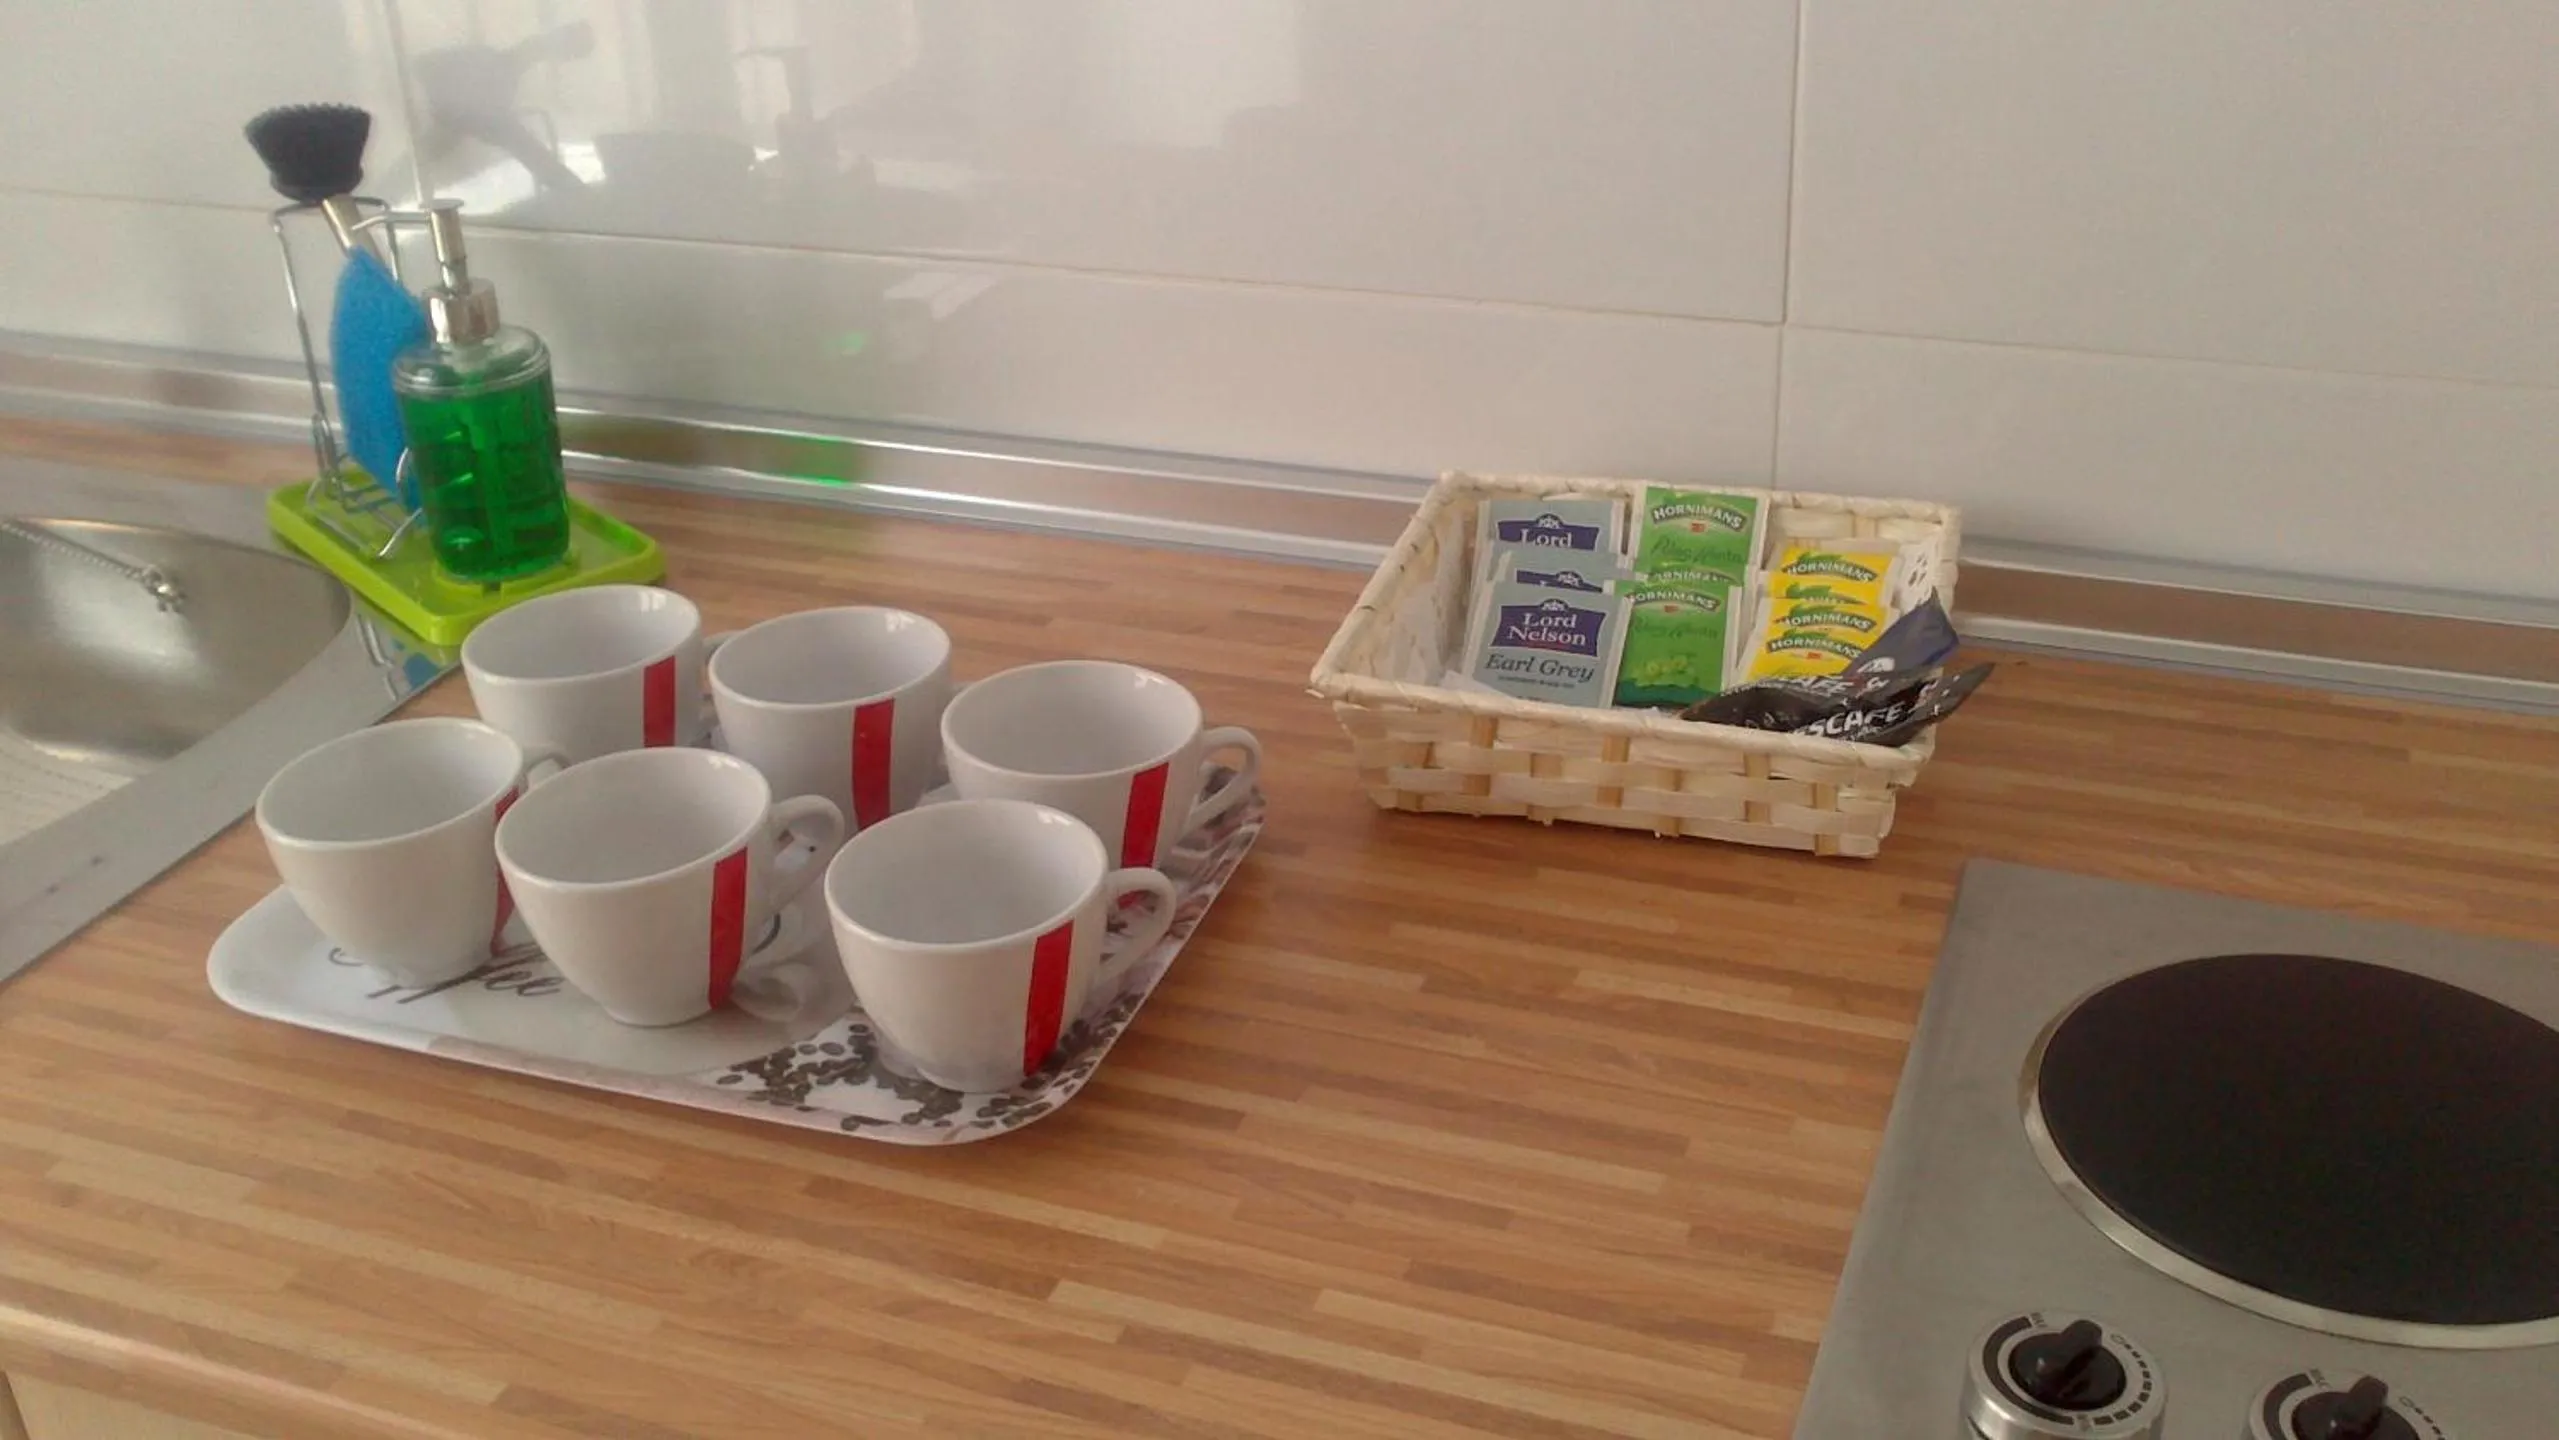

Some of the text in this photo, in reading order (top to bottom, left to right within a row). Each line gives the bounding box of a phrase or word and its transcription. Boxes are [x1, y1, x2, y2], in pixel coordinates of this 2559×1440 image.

[1654, 504, 1743, 529] HORNIMANS
[1520, 528, 1572, 548] Lord
[1523, 612, 1577, 628] Lord
[1506, 625, 1586, 647] Nelson
[1485, 654, 1535, 673] Earl
[1539, 659, 1596, 684] Grey
